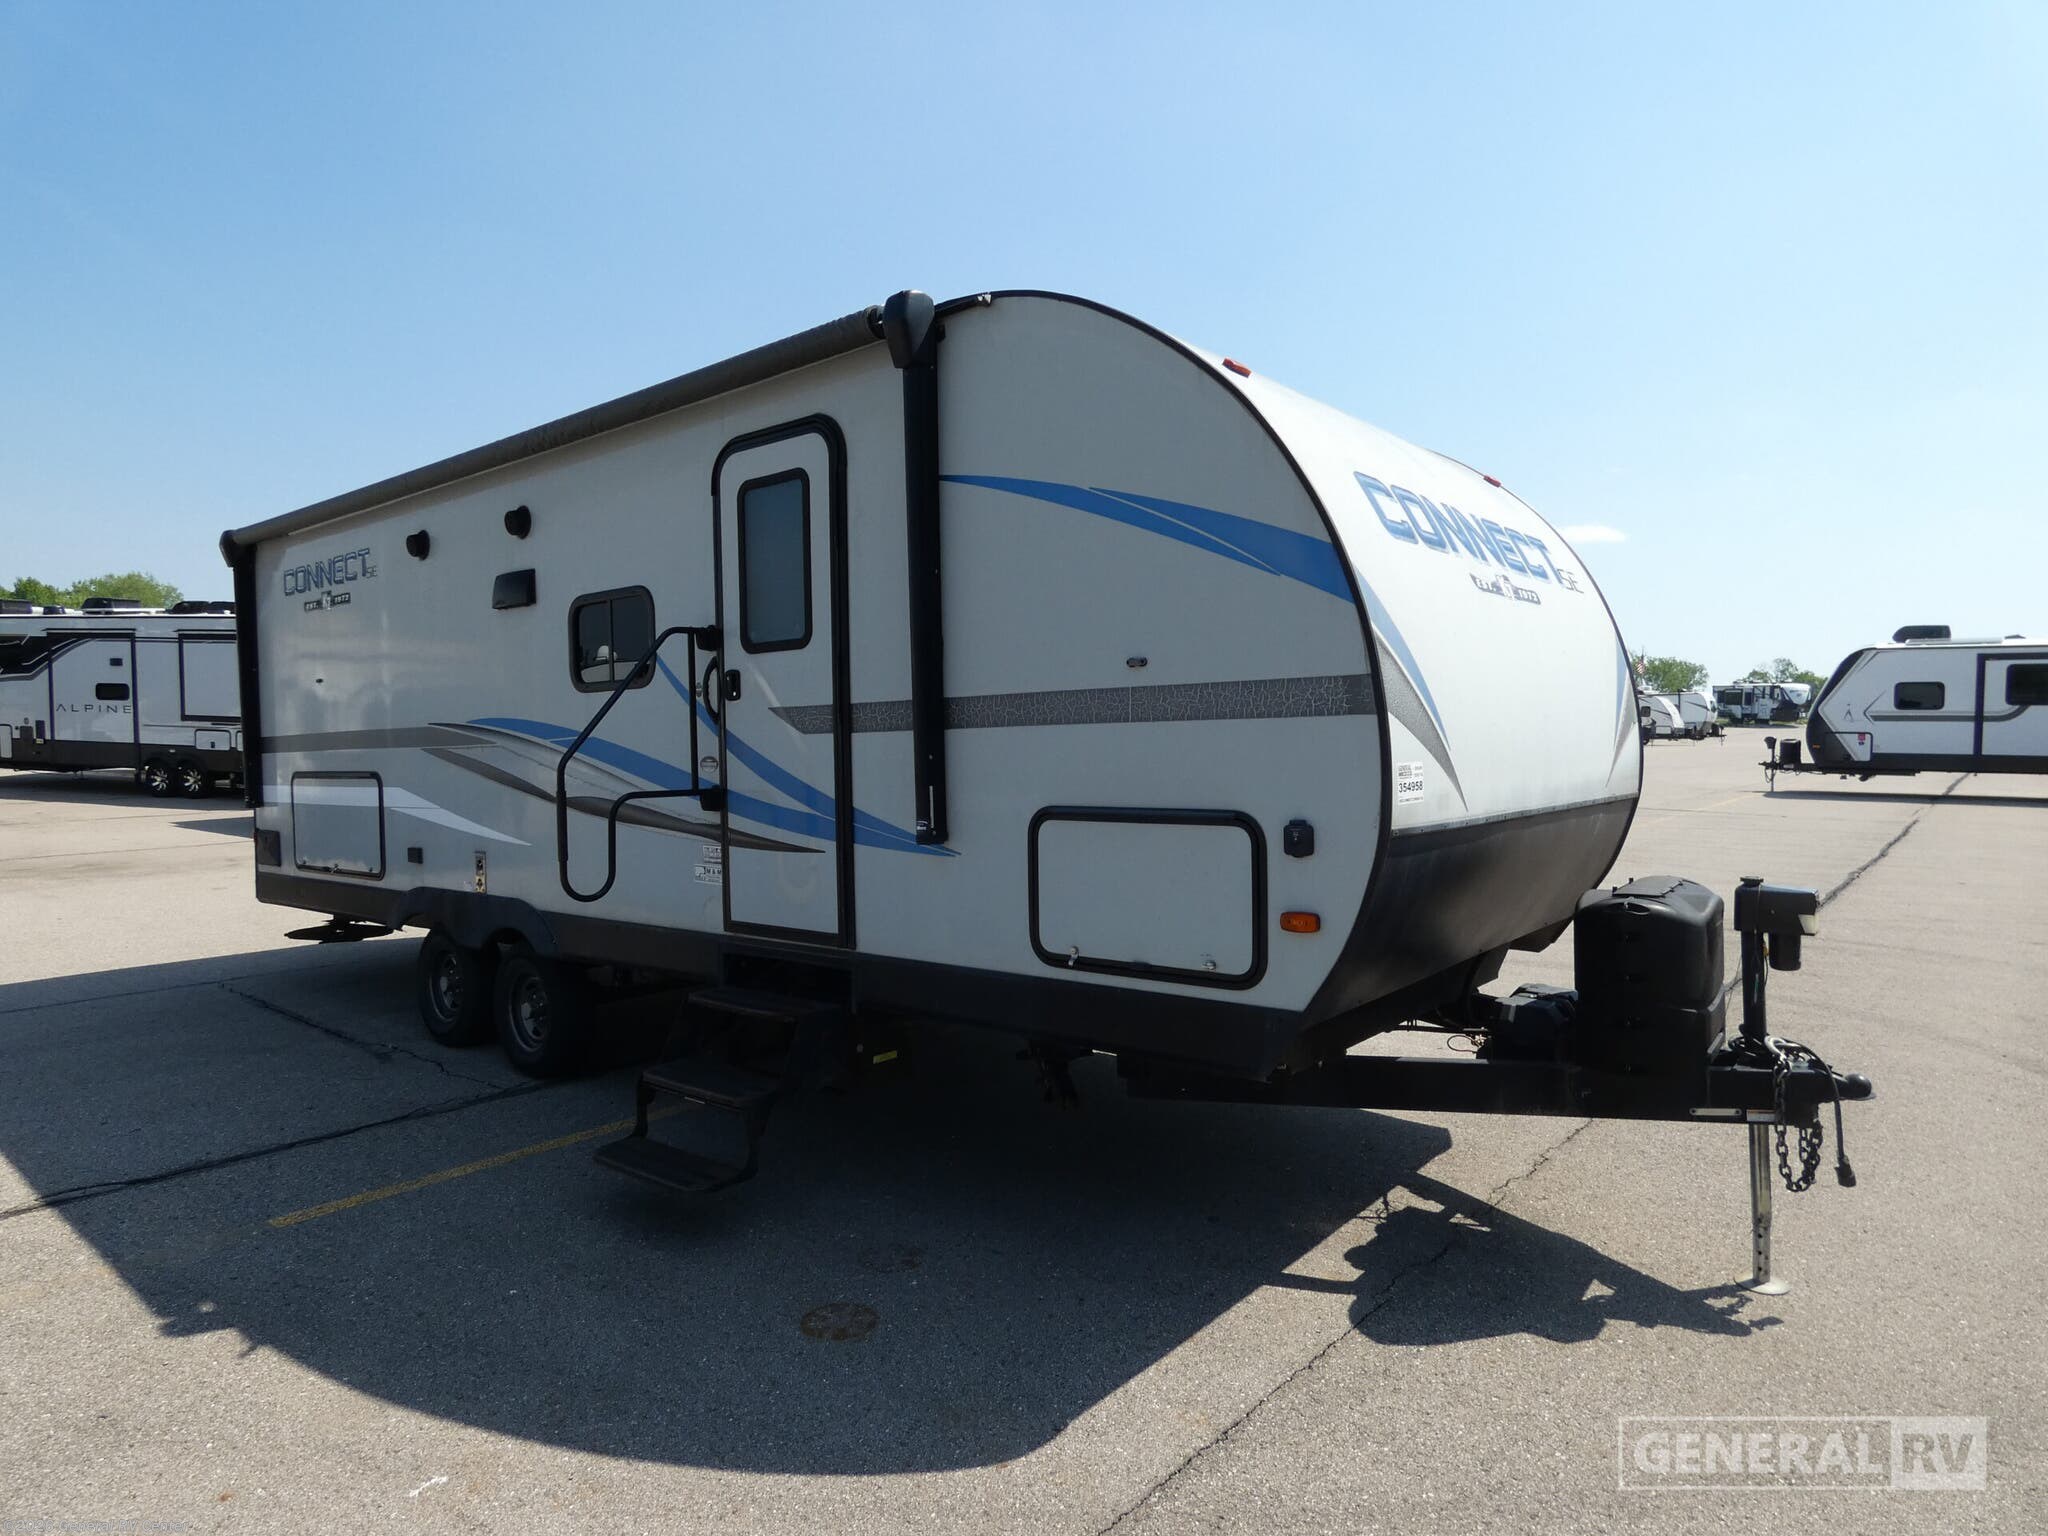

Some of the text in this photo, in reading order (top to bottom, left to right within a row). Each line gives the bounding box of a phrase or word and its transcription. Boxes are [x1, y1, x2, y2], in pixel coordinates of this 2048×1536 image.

[1353, 471, 1585, 594] CONNECT SE
[283, 548, 370, 596] CONNECT
[56, 703, 132, 714] ALPINE
[1399, 780, 1423, 792] 354958
